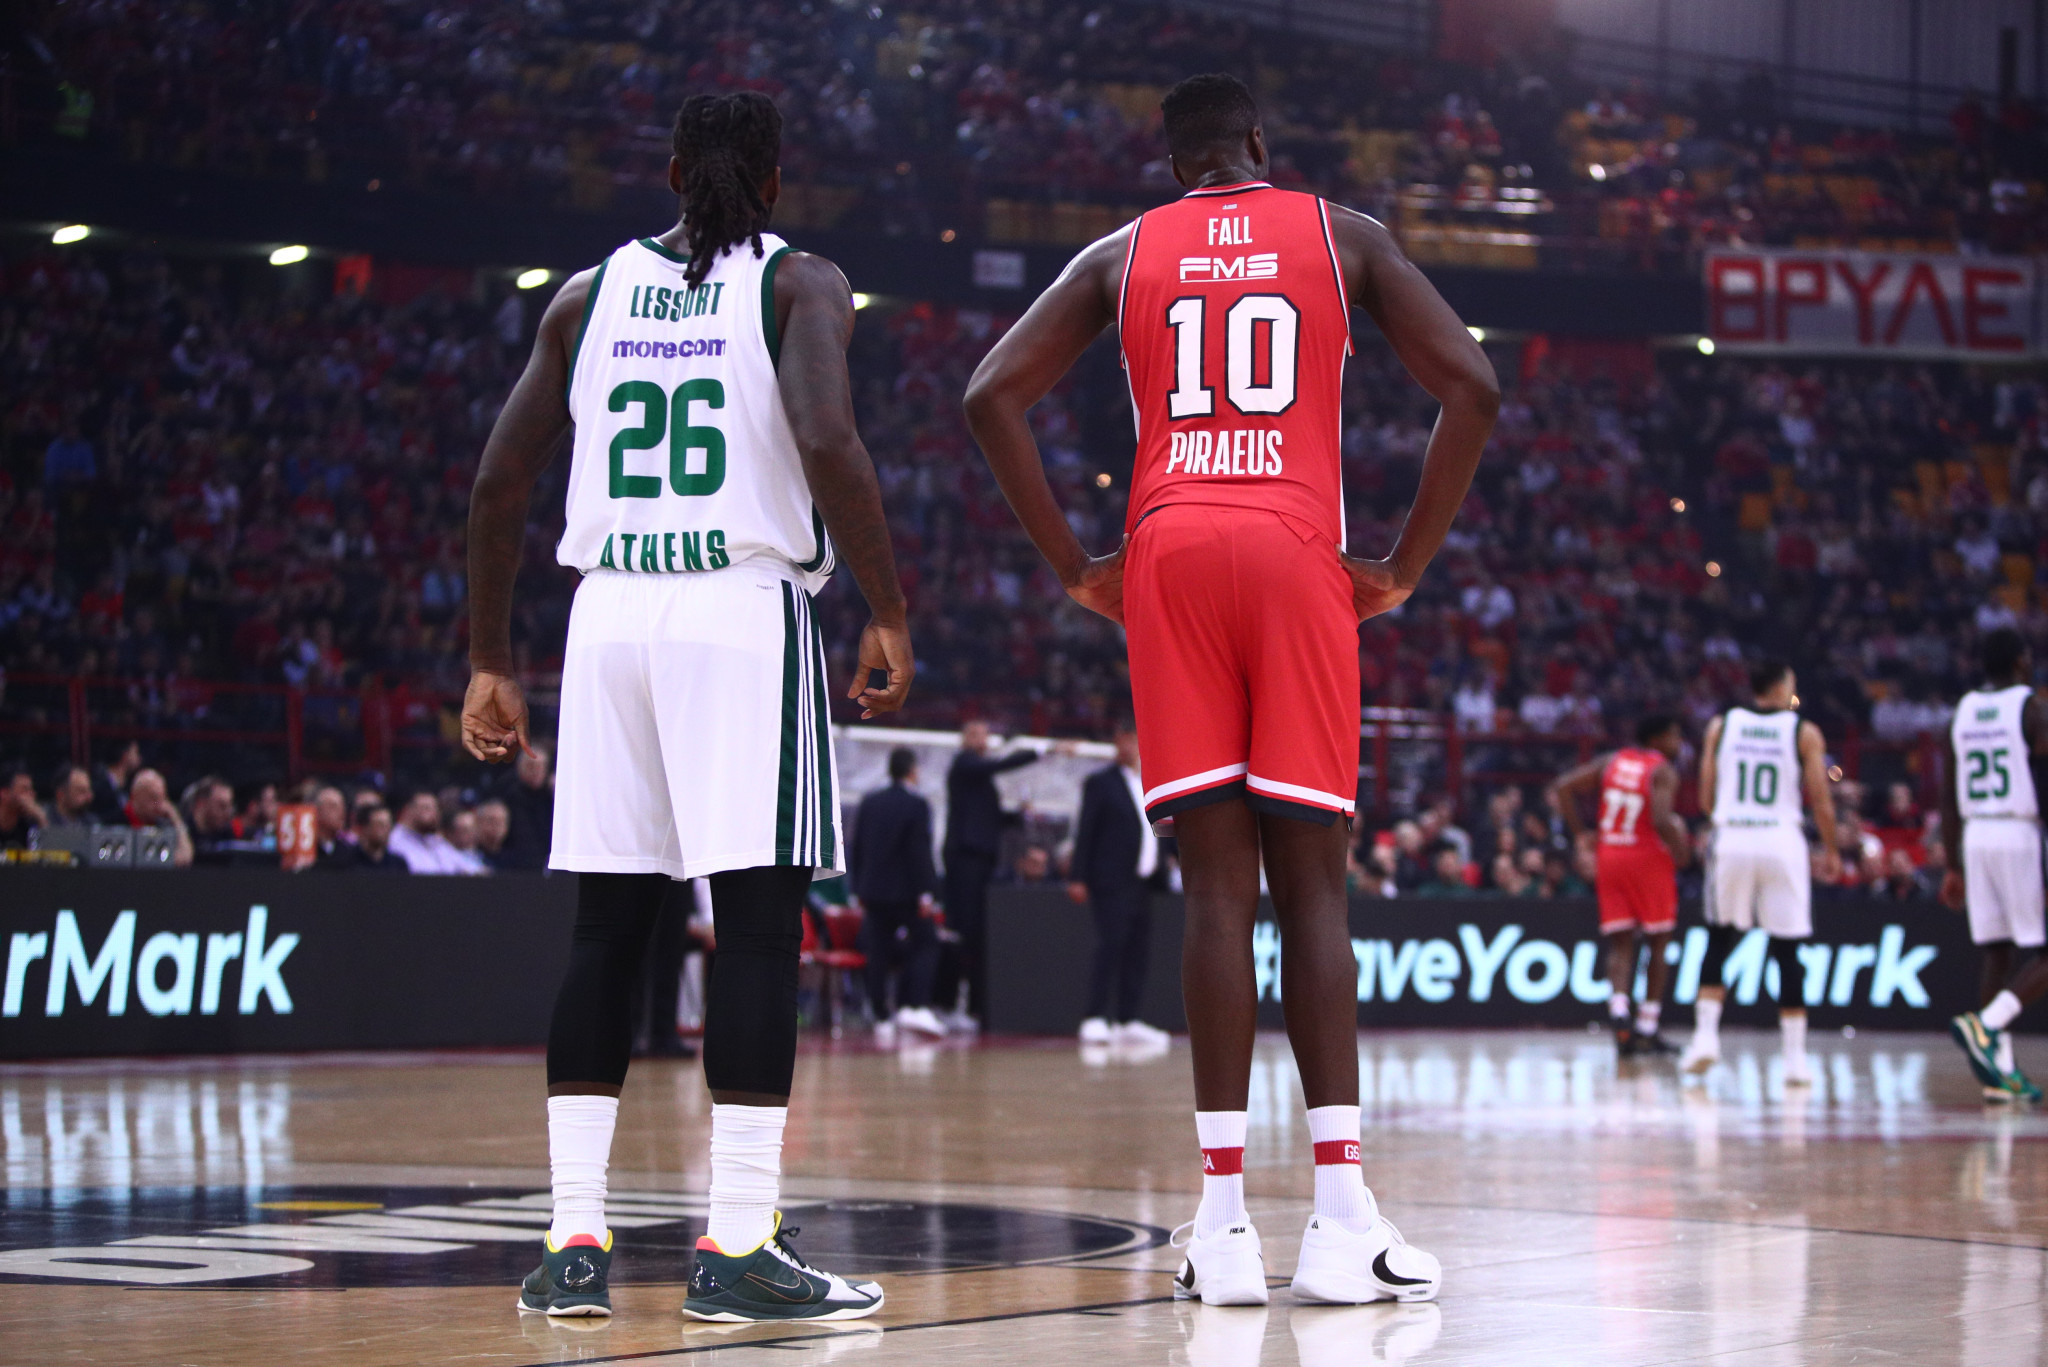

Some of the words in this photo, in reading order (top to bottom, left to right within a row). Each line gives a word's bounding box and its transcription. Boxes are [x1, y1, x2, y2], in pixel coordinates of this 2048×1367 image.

[1208, 216, 1253, 246] FALL
[1179, 253, 1279, 281] FMS
[630, 282, 726, 322] LESSORT
[1166, 292, 1301, 421] 10
[608, 378, 727, 499] 26
[1165, 430, 1283, 476] PIRAEUS
[599, 529, 731, 574] ATHENS
[1737, 760, 1779, 807] 10
[1966, 748, 2009, 800] 25
[1601, 788, 1645, 835] 77
